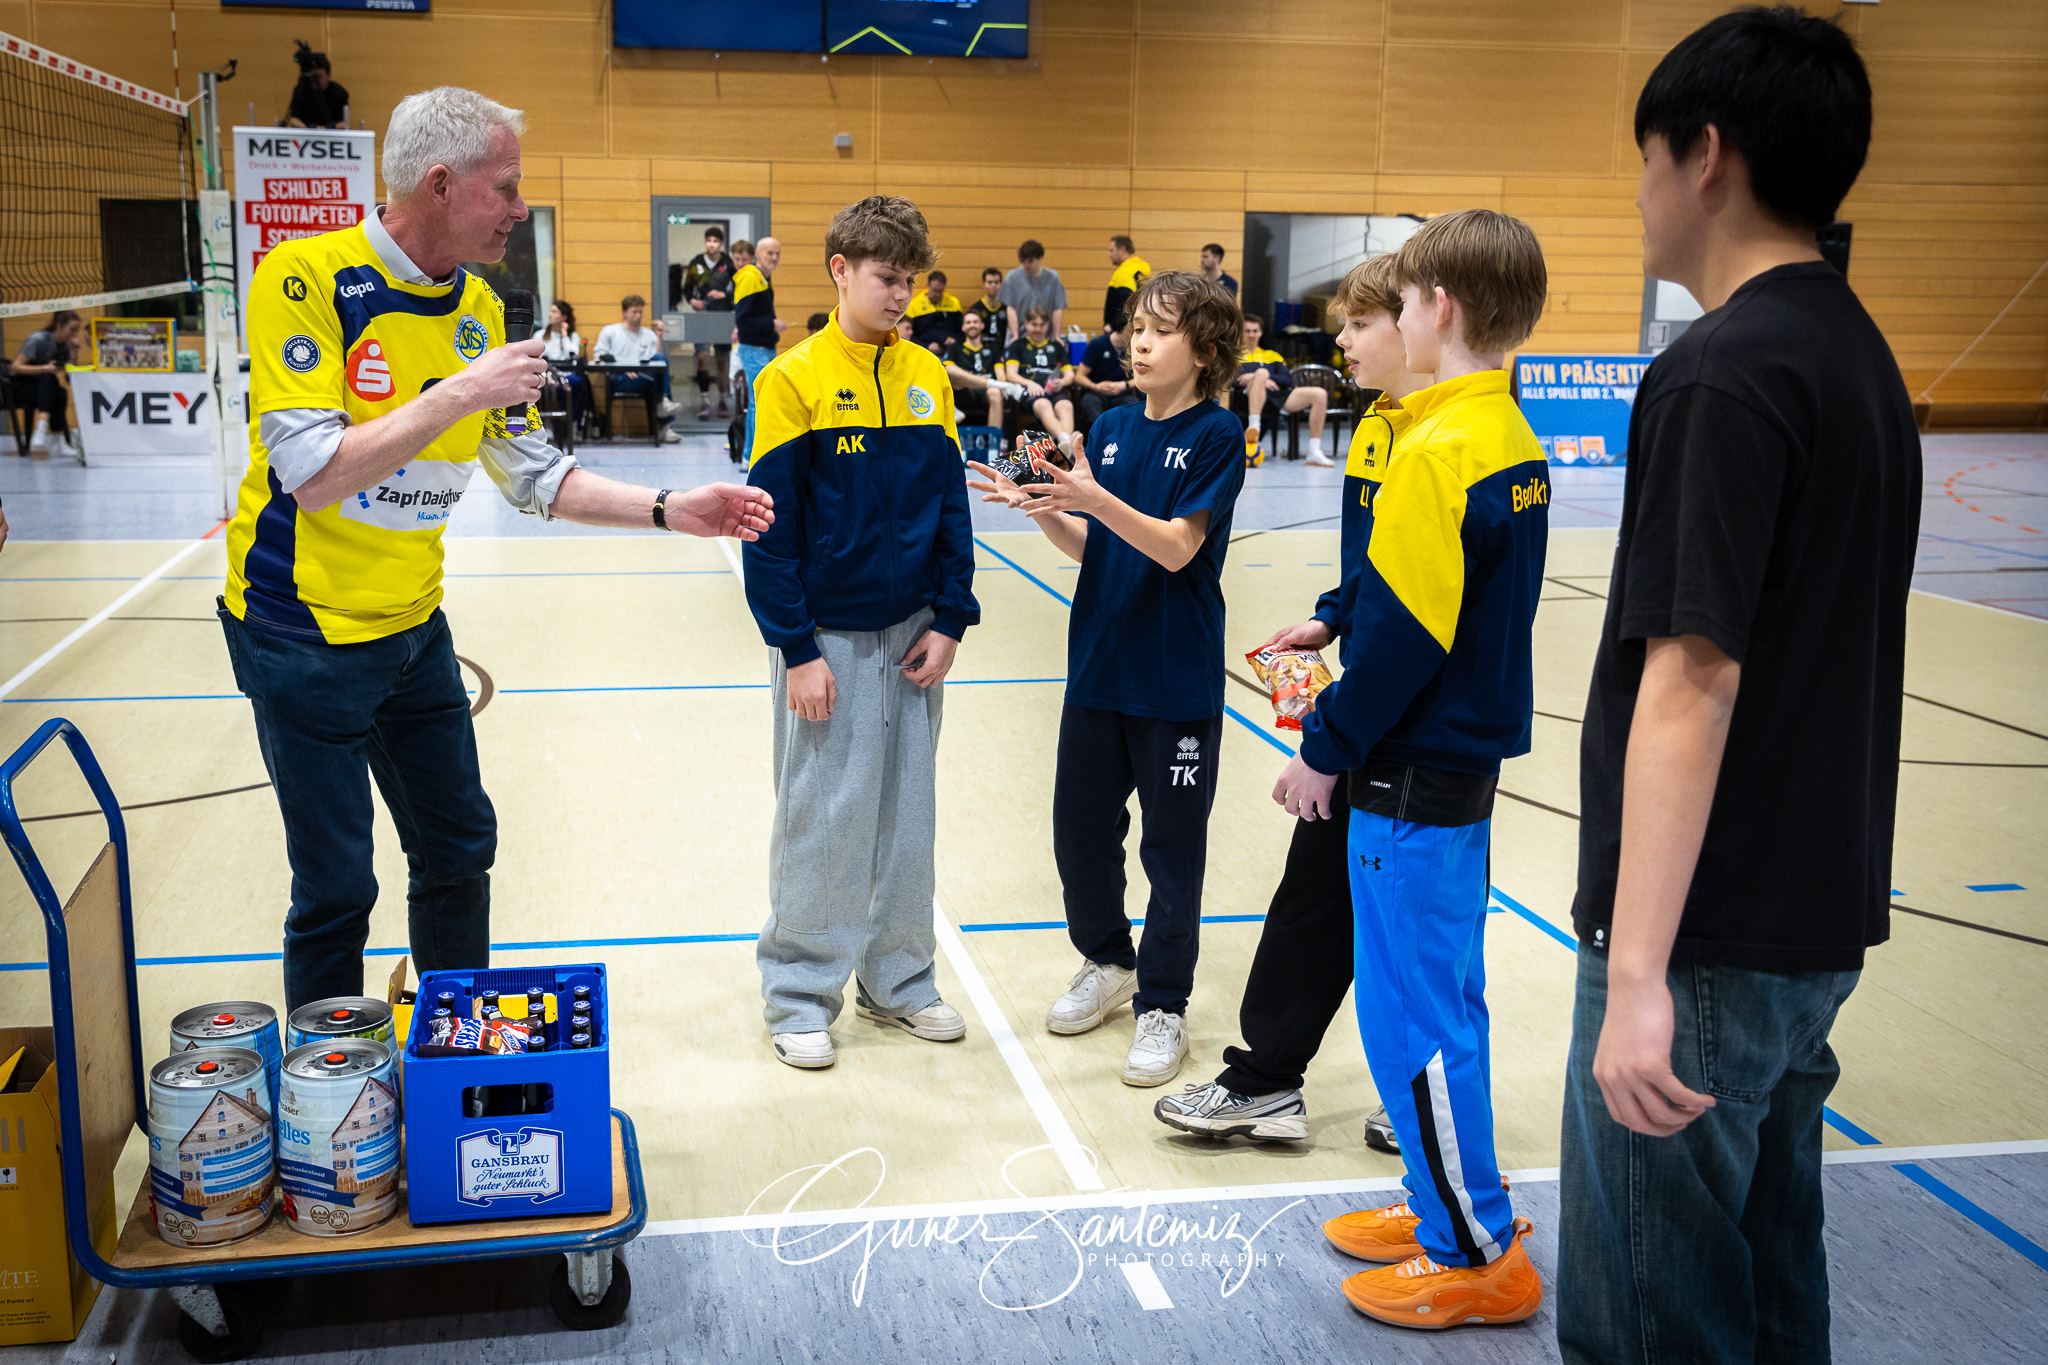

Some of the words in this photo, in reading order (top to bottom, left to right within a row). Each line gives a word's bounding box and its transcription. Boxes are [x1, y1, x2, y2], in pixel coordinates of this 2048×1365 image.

[248, 138, 361, 160] MEYSEL
[249, 161, 278, 170] Druck
[291, 163, 360, 172] Werbetechnik
[267, 179, 342, 200] SCHILDER
[251, 203, 357, 225] FOTOTAPETEN
[287, 339, 315, 351] VOLLEYBALL
[287, 357, 316, 369] BUNDESLIGA
[1520, 363, 1556, 385] DYN
[1521, 387, 1545, 399] ALLE
[1546, 387, 1580, 399] SPIELE
[1581, 387, 1600, 399] DER
[1602, 387, 1613, 399] 2.
[91, 391, 208, 424] MEY
[837, 402, 859, 411] errea
[836, 434, 866, 455] AK
[1024, 438, 1056, 476] Ma
[1164, 446, 1191, 470] TK
[375, 485, 420, 508] Zapf
[1176, 752, 1200, 760] errea
[1169, 765, 1200, 786] TK
[280, 1102, 300, 1116] raser
[279, 1120, 311, 1146] elles
[471, 1154, 550, 1168] GANSBRÄU
[476, 1166, 544, 1183] Neumarkt's
[471, 1182, 502, 1194] guter
[502, 1177, 550, 1191] Schluck
